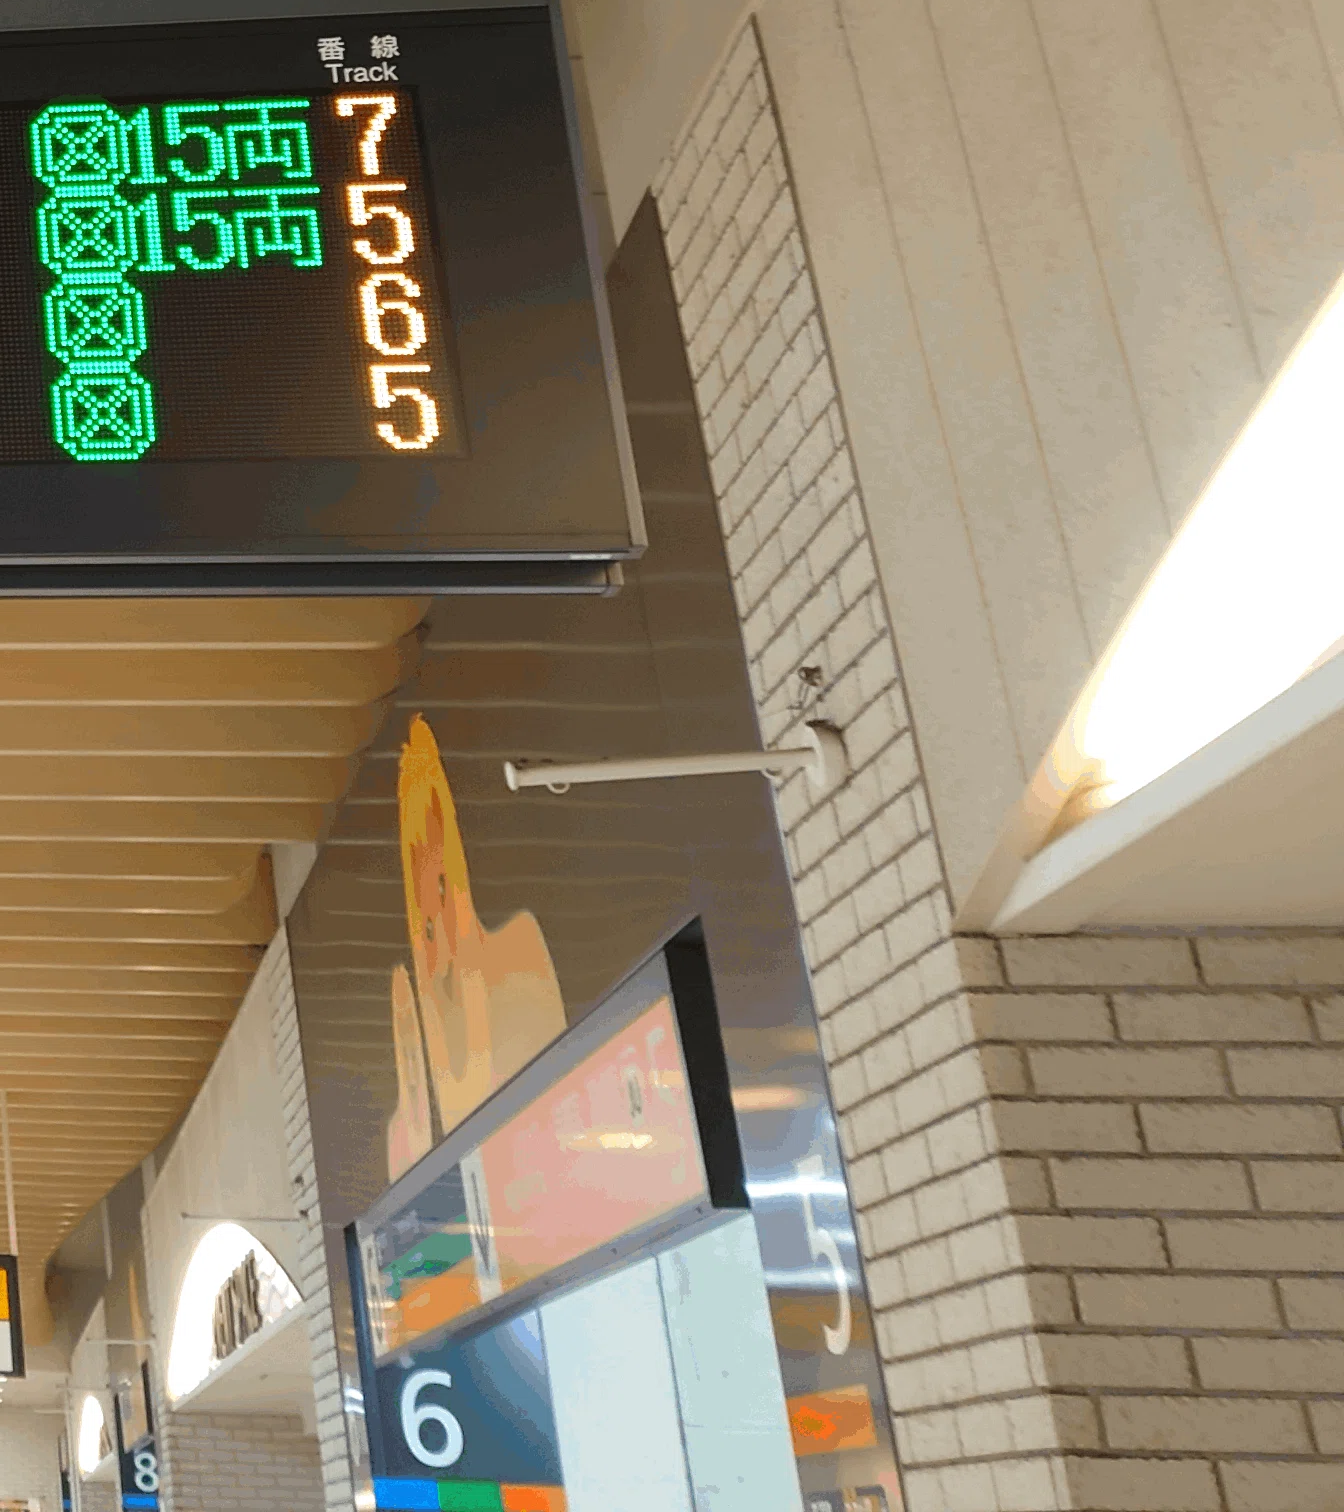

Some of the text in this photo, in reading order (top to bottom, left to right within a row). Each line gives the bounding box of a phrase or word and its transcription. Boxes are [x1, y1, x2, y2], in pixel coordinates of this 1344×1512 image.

[325, 61, 399, 84] Track
[120, 98, 311, 185] 15両
[334, 95, 398, 177] 7
[128, 186, 323, 273] 15両
[346, 183, 416, 265] 5
[359, 271, 428, 356] 6
[368, 364, 441, 451] 5
[399, 1367, 465, 1469] 6
[134, 1451, 160, 1493] 8
